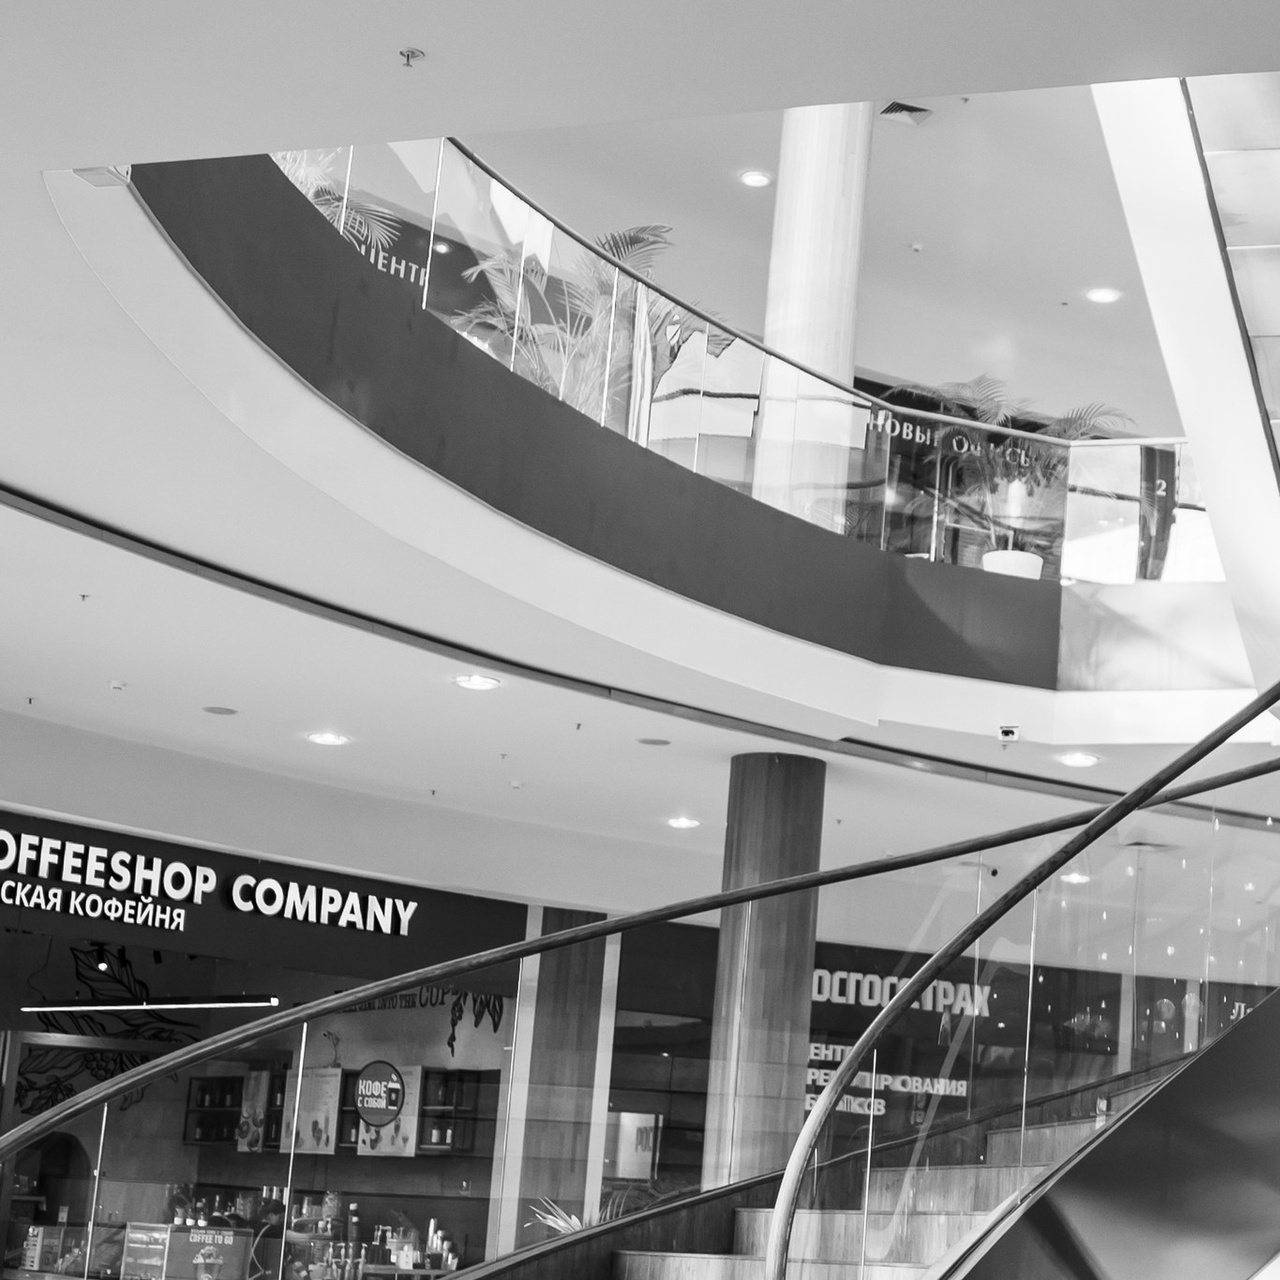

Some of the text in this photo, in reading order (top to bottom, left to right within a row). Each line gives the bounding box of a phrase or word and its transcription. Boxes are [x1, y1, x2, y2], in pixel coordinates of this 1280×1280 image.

[1, 880, 186, 932] СКАЯ КОФЕЙНЯ
[232, 874, 418, 936] COMPANY
[358, 1079, 387, 1097] КОФЕ
